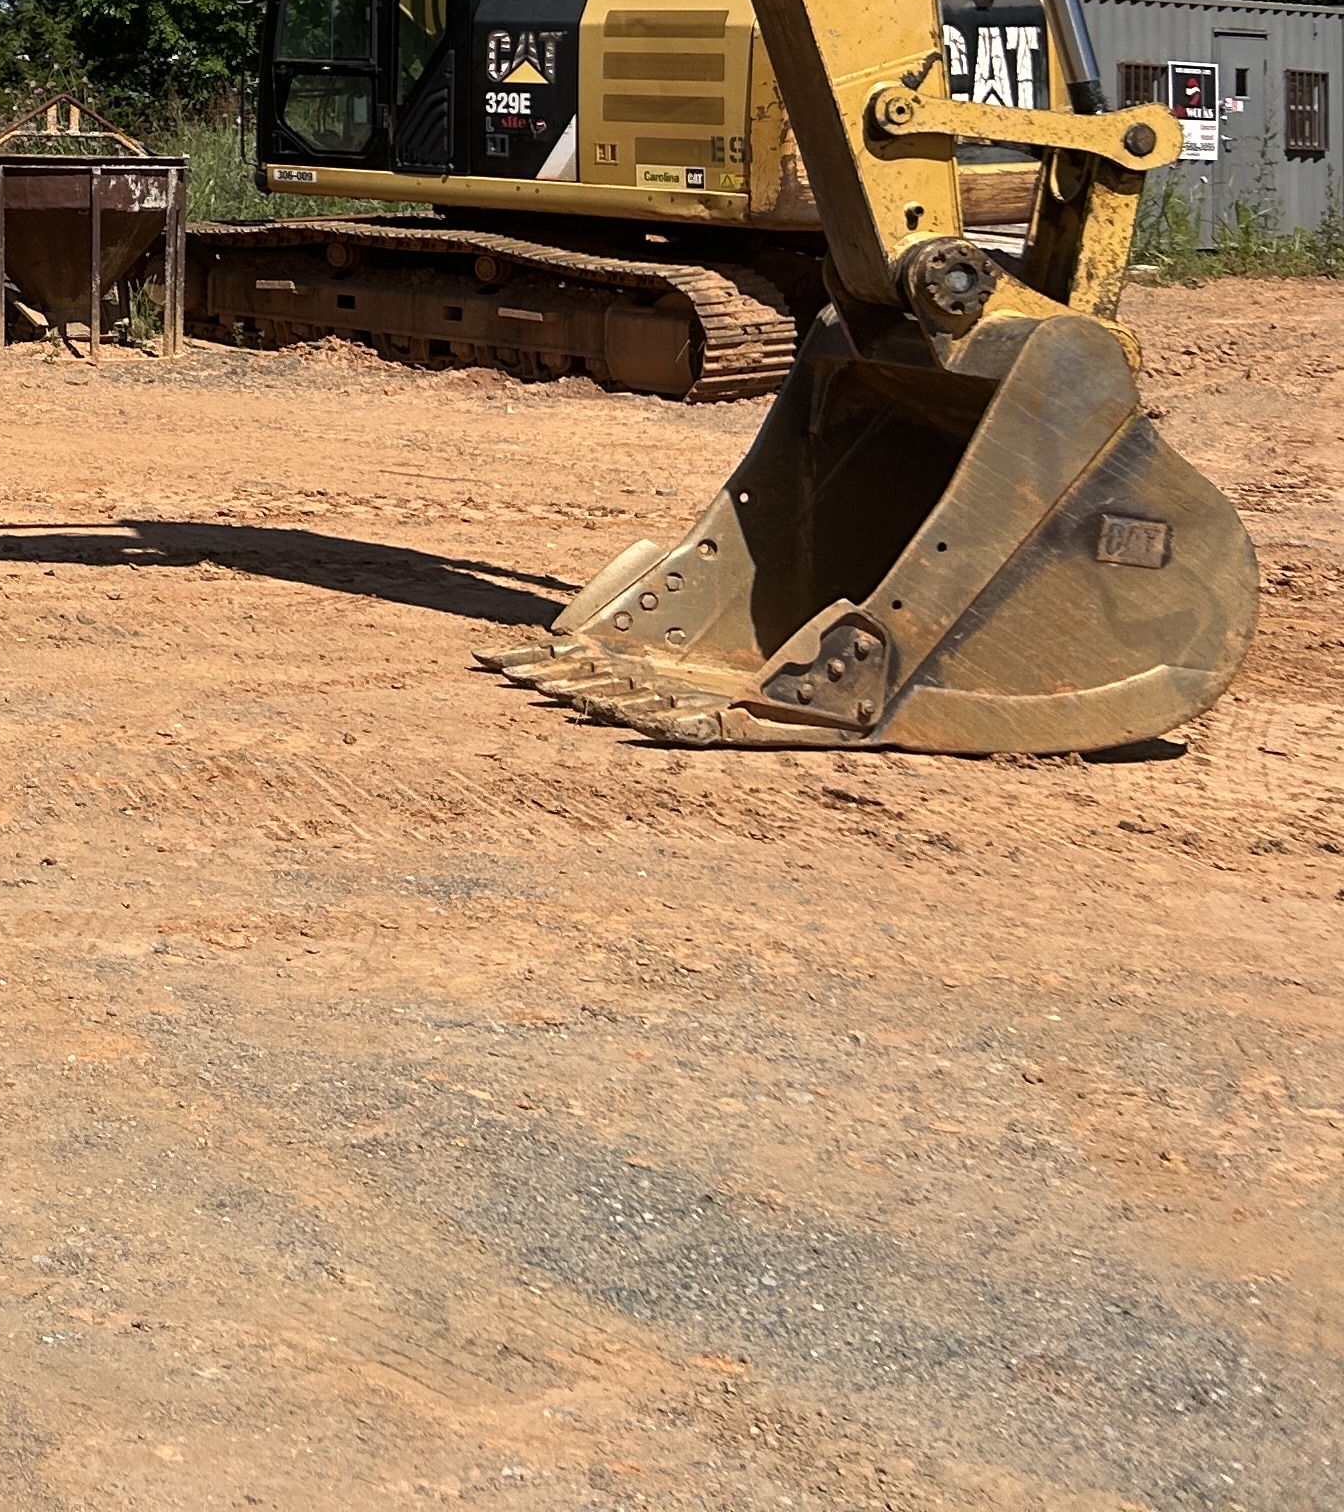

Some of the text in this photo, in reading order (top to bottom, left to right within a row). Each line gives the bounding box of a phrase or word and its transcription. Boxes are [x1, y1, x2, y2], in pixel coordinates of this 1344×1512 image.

[487, 30, 563, 84] CAT
[485, 92, 531, 114] 329E
[644, 170, 679, 183] Carolina
[687, 173, 703, 184] CAT
